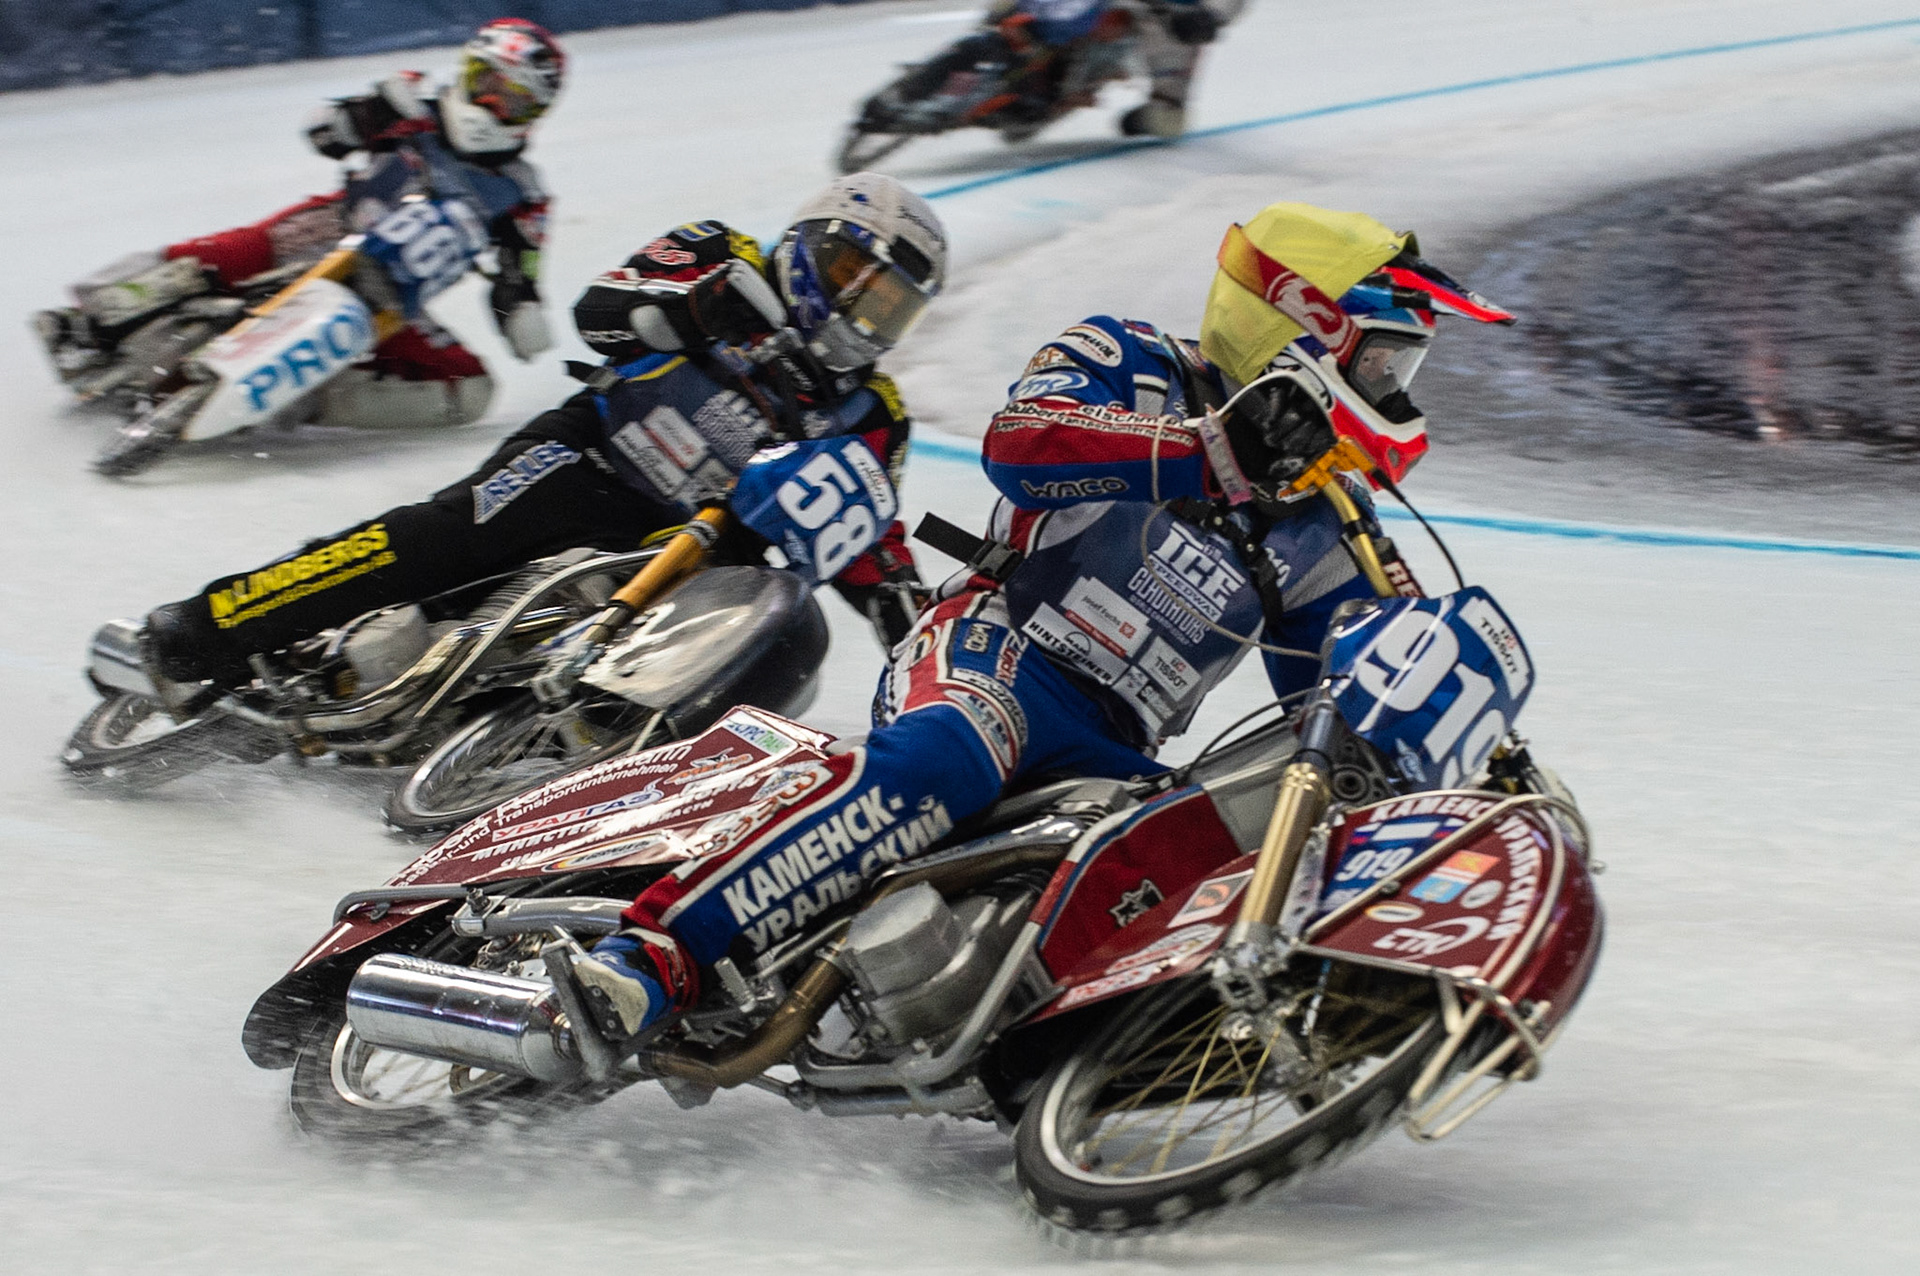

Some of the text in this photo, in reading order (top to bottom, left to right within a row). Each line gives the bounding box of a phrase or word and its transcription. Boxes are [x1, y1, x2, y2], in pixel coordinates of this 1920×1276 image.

[776, 452, 875, 582] 58
[1020, 477, 1129, 499] WACO
[1153, 528, 1242, 611] ICE
[1028, 621, 1113, 682] HINTSTEINER
[1153, 656, 1188, 688] TISSOT
[1481, 617, 1518, 675] TISSOT
[493, 763, 678, 827] Transportunternehmen
[499, 792, 652, 838] УРАЛГАЗ
[1335, 847, 1414, 882] 919
